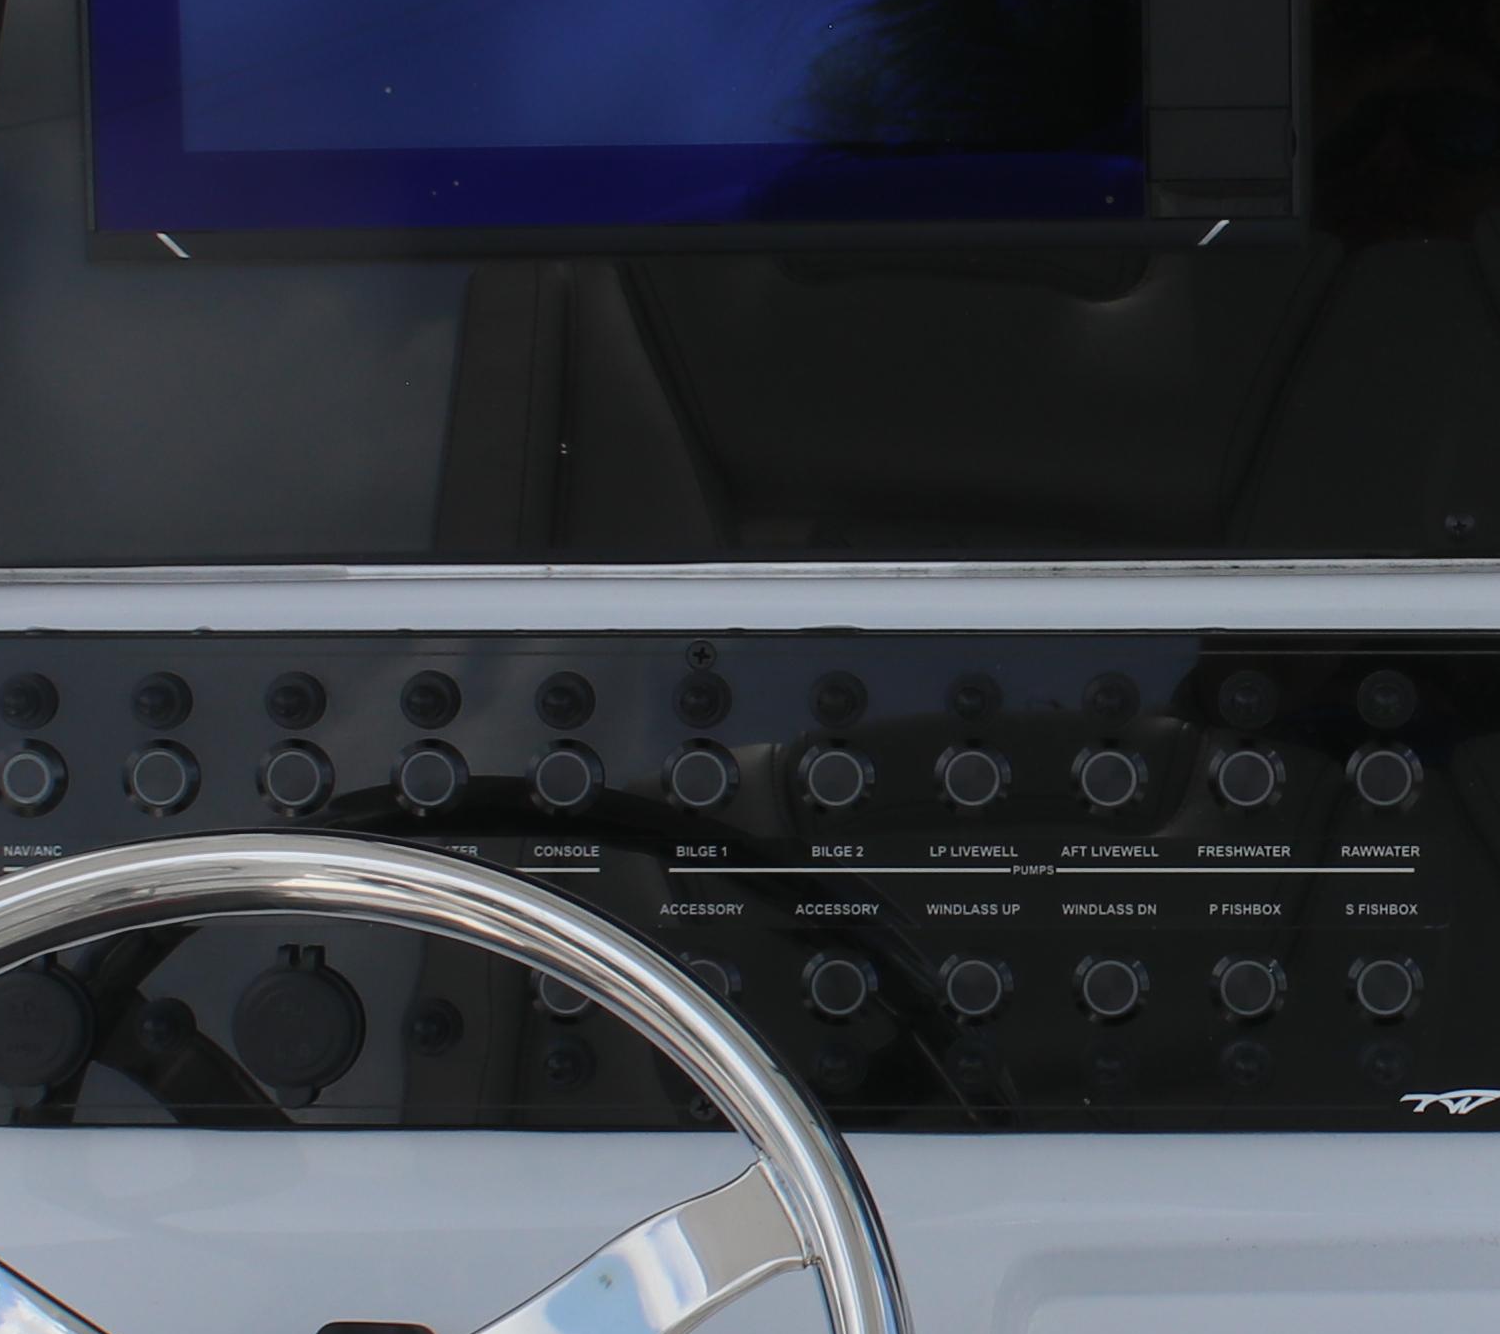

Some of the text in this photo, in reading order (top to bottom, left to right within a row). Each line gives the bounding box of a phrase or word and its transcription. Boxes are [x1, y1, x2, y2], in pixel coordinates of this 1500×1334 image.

[533, 845, 600, 857] CONSOLE
[676, 846, 728, 857] BILGE 1
[811, 846, 864, 857] BILGE 2
[930, 846, 1019, 857] LP LIVEWELL
[1061, 846, 1159, 857] AFT LIVEWELL
[1198, 845, 1291, 857] FRESHWATER
[1341, 845, 1420, 857] RAWWATER
[1013, 865, 1055, 876] PUMPS
[660, 904, 744, 915] ACCESSORY
[795, 904, 880, 915] ACCESSORY
[926, 904, 1021, 915] WINDLASS UP
[1062, 904, 1157, 915] WINDLASS DN
[1209, 903, 1282, 915] P FISHBOX
[1346, 903, 1418, 915] S FISHBOX
